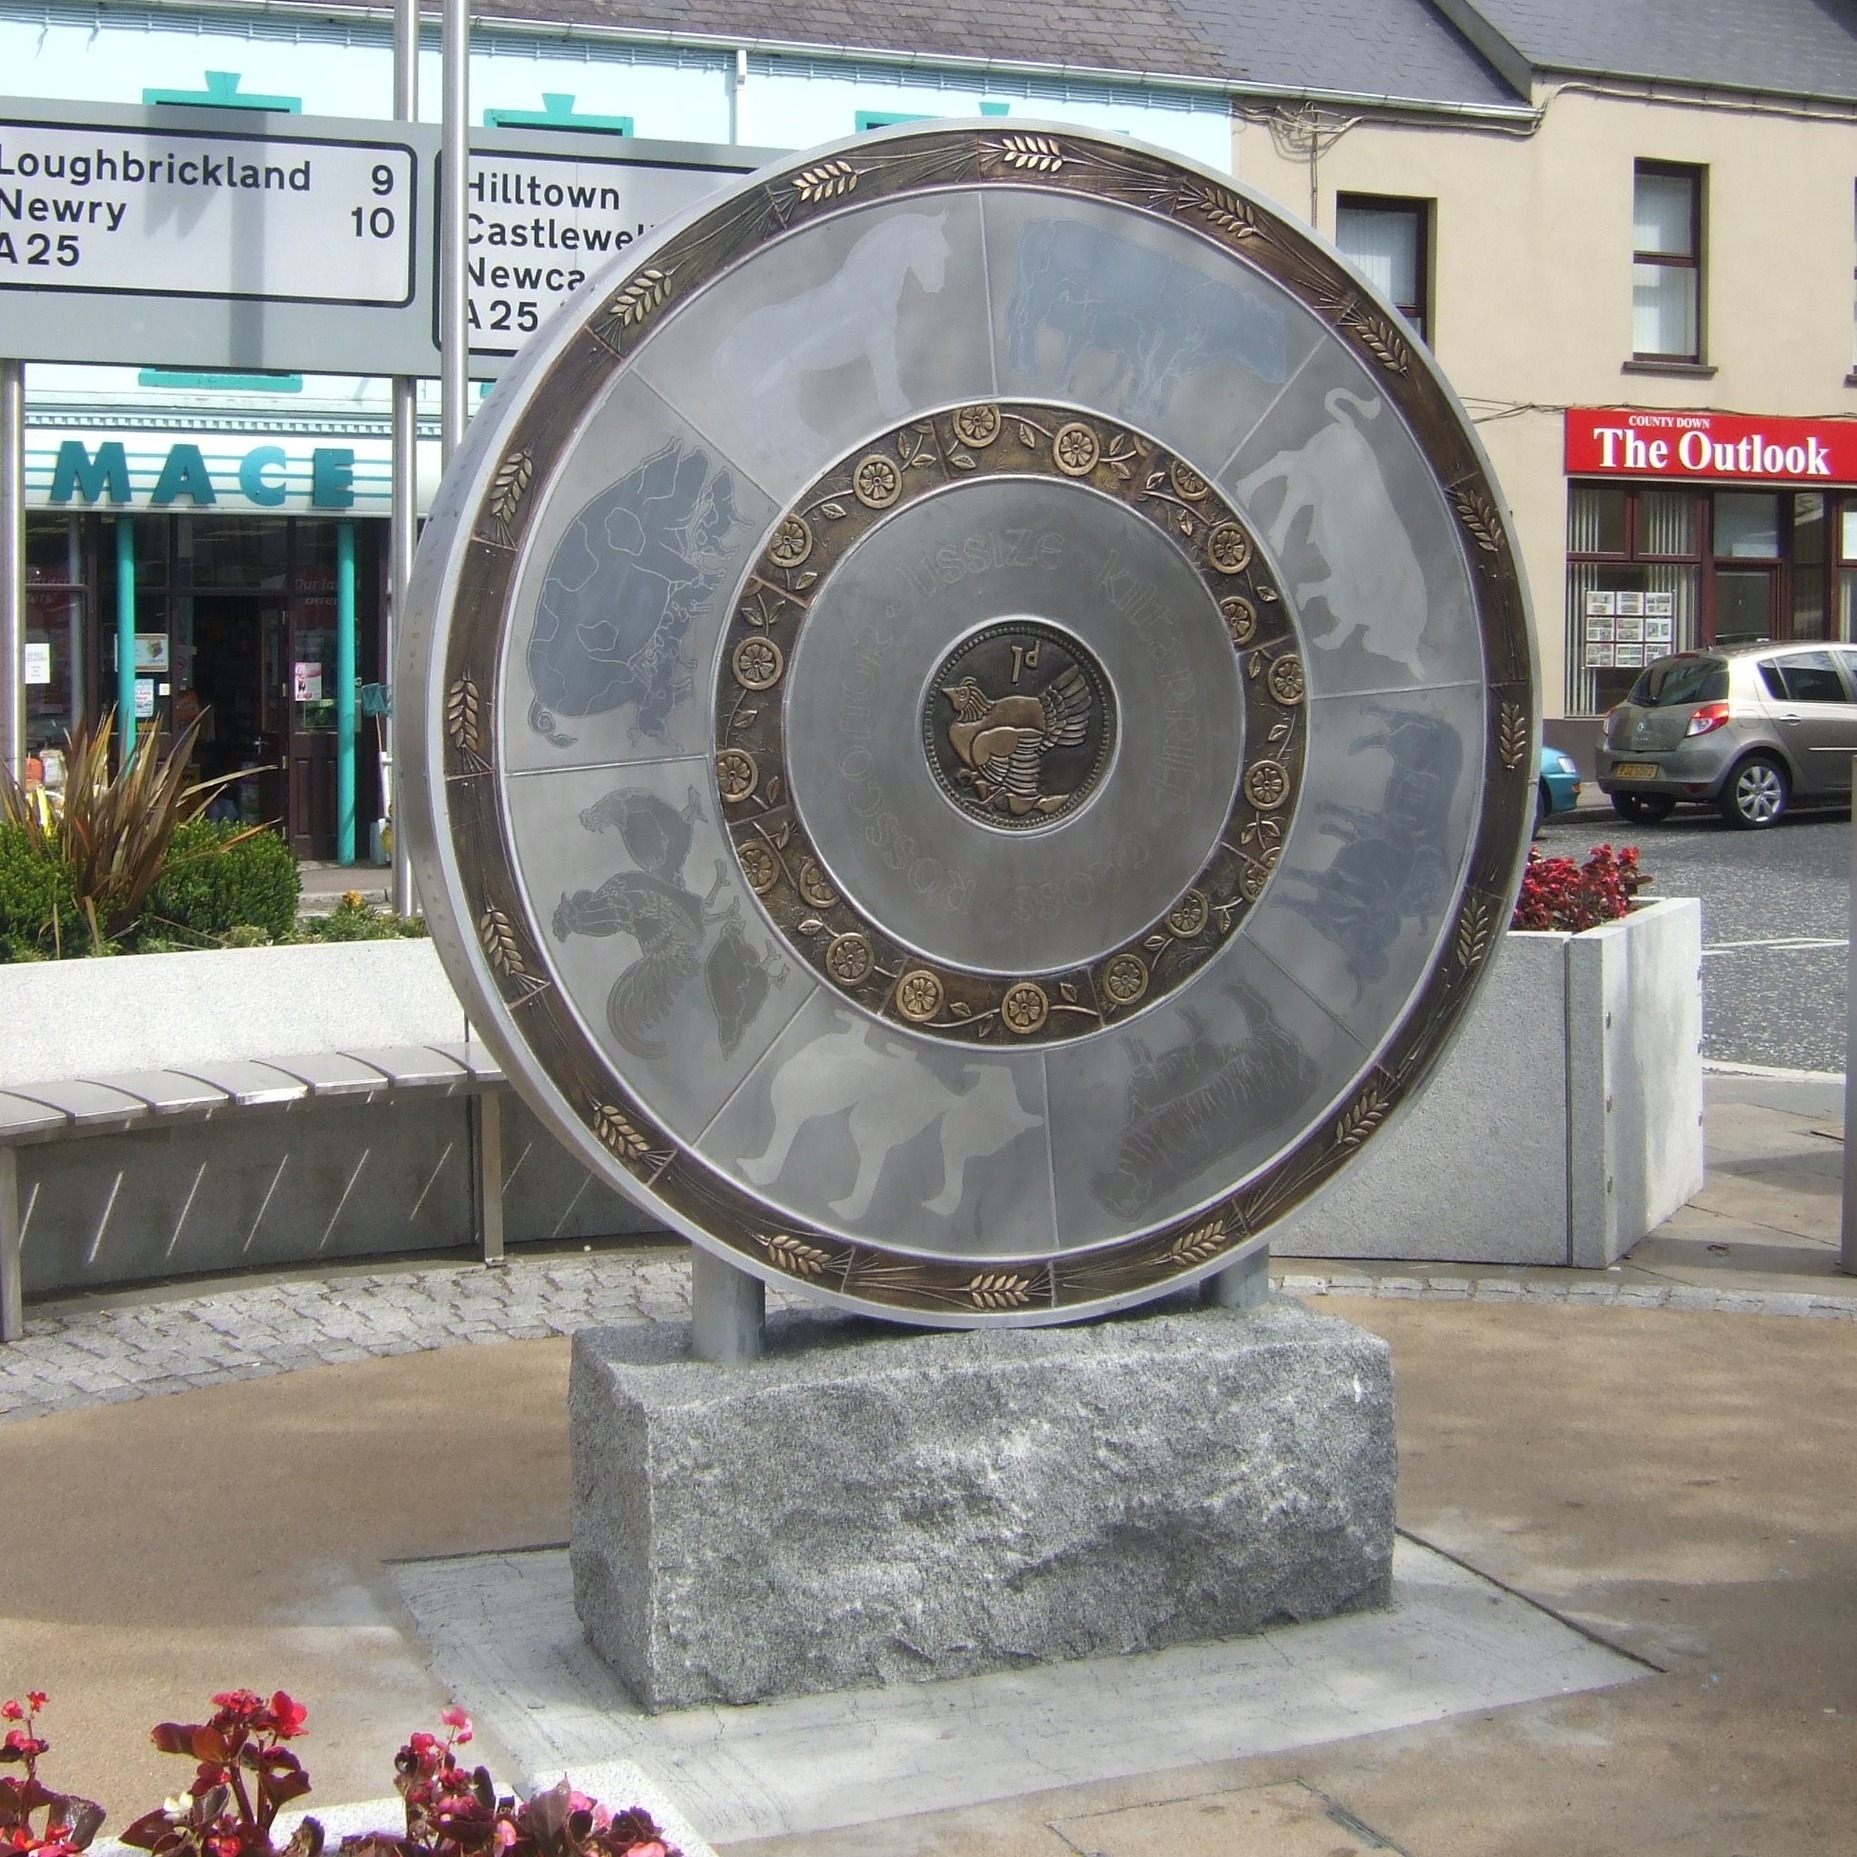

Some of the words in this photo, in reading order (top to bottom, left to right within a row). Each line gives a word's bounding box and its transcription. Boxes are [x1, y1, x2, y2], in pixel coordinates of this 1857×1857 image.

[0, 144, 311, 191] Loughbrickland
[371, 164, 394, 196] 9
[468, 172, 620, 210] Hilltown
[0, 188, 127, 232] Newry
[351, 206, 395, 238] 10
[468, 213, 654, 251] Castlewe
[0, 232, 80, 267] A25
[468, 257, 585, 291] Newca
[468, 299, 539, 332] A25
[1628, 415, 1673, 427] COUNTY
[1676, 417, 1710, 429] DOWN
[1593, 428, 1668, 469] The
[1678, 430, 1831, 475] Outlook
[49, 440, 356, 508] MACE
